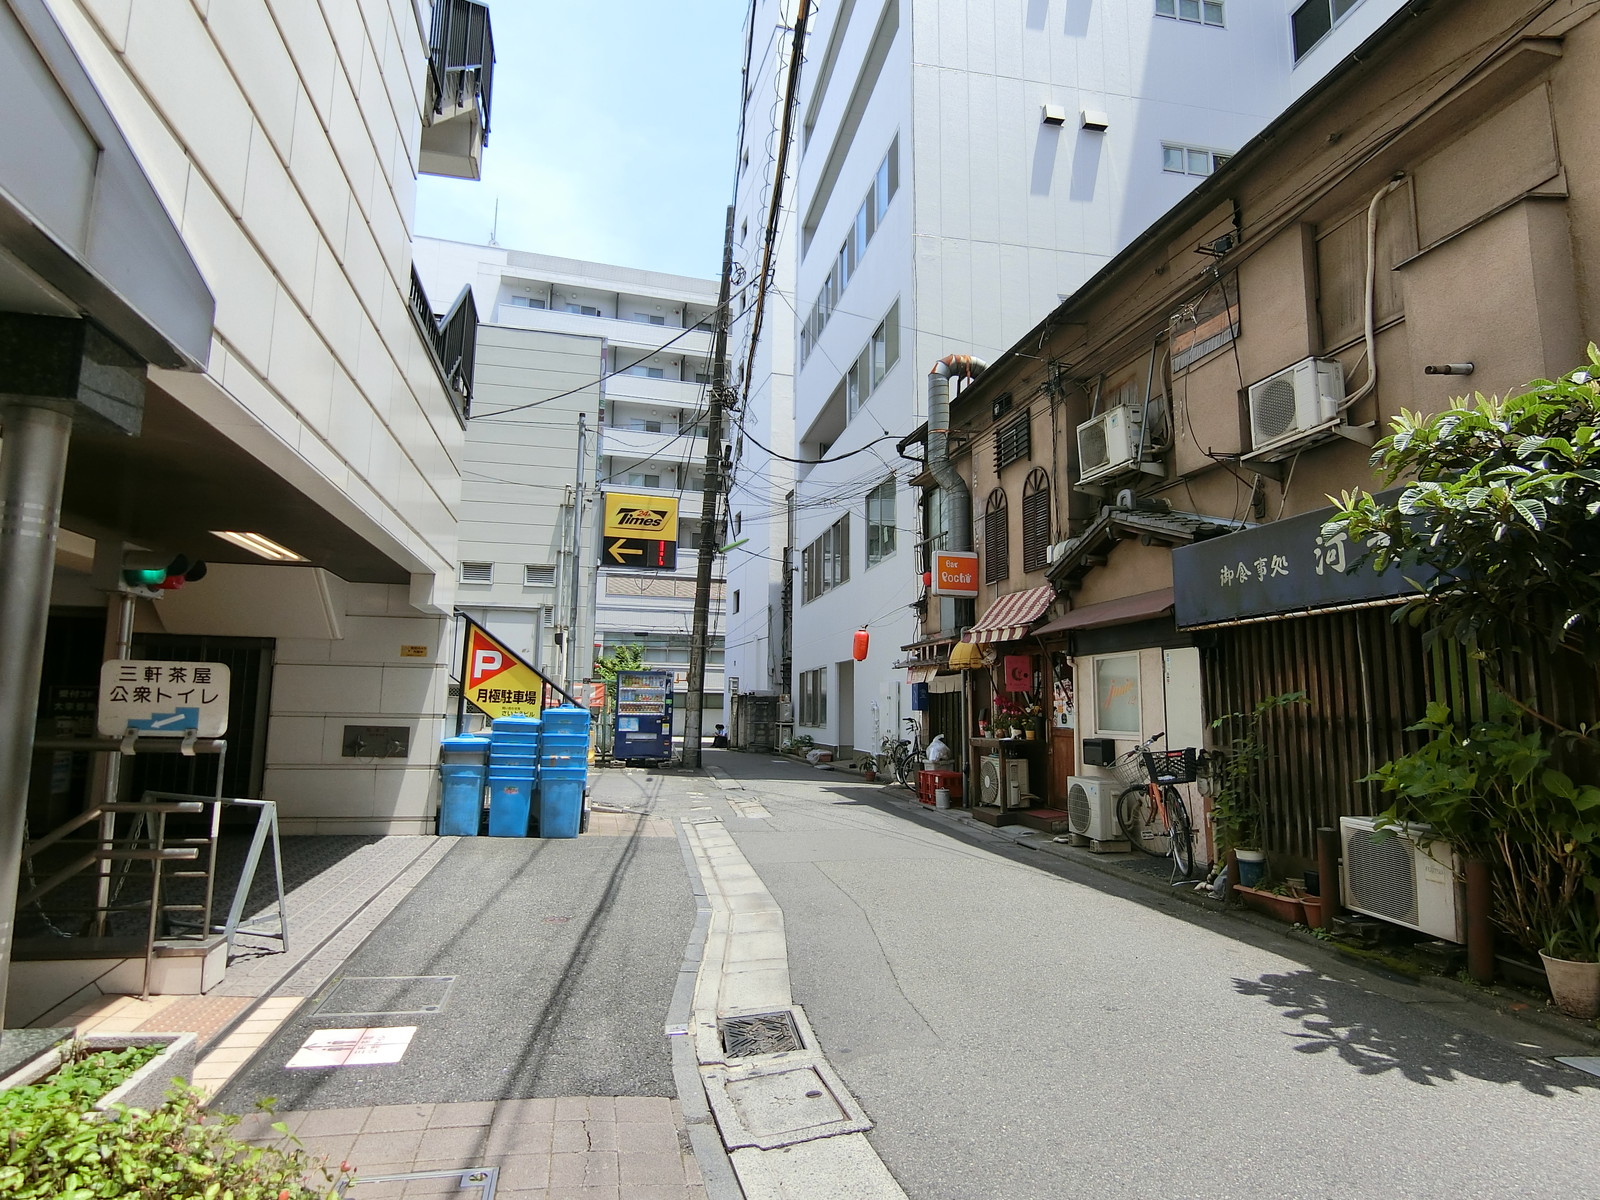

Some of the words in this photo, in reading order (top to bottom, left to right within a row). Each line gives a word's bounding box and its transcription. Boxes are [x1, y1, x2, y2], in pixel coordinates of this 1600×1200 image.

[616, 508, 668, 527] Times
[945, 560, 959, 568] Bar
[1220, 554, 1290, 588] 御食事処
[473, 649, 503, 678] P
[119, 666, 212, 684] 三軒茶屋
[110, 686, 219, 704] 公衆トイレ
[476, 689, 537, 705] 月極駐車場
